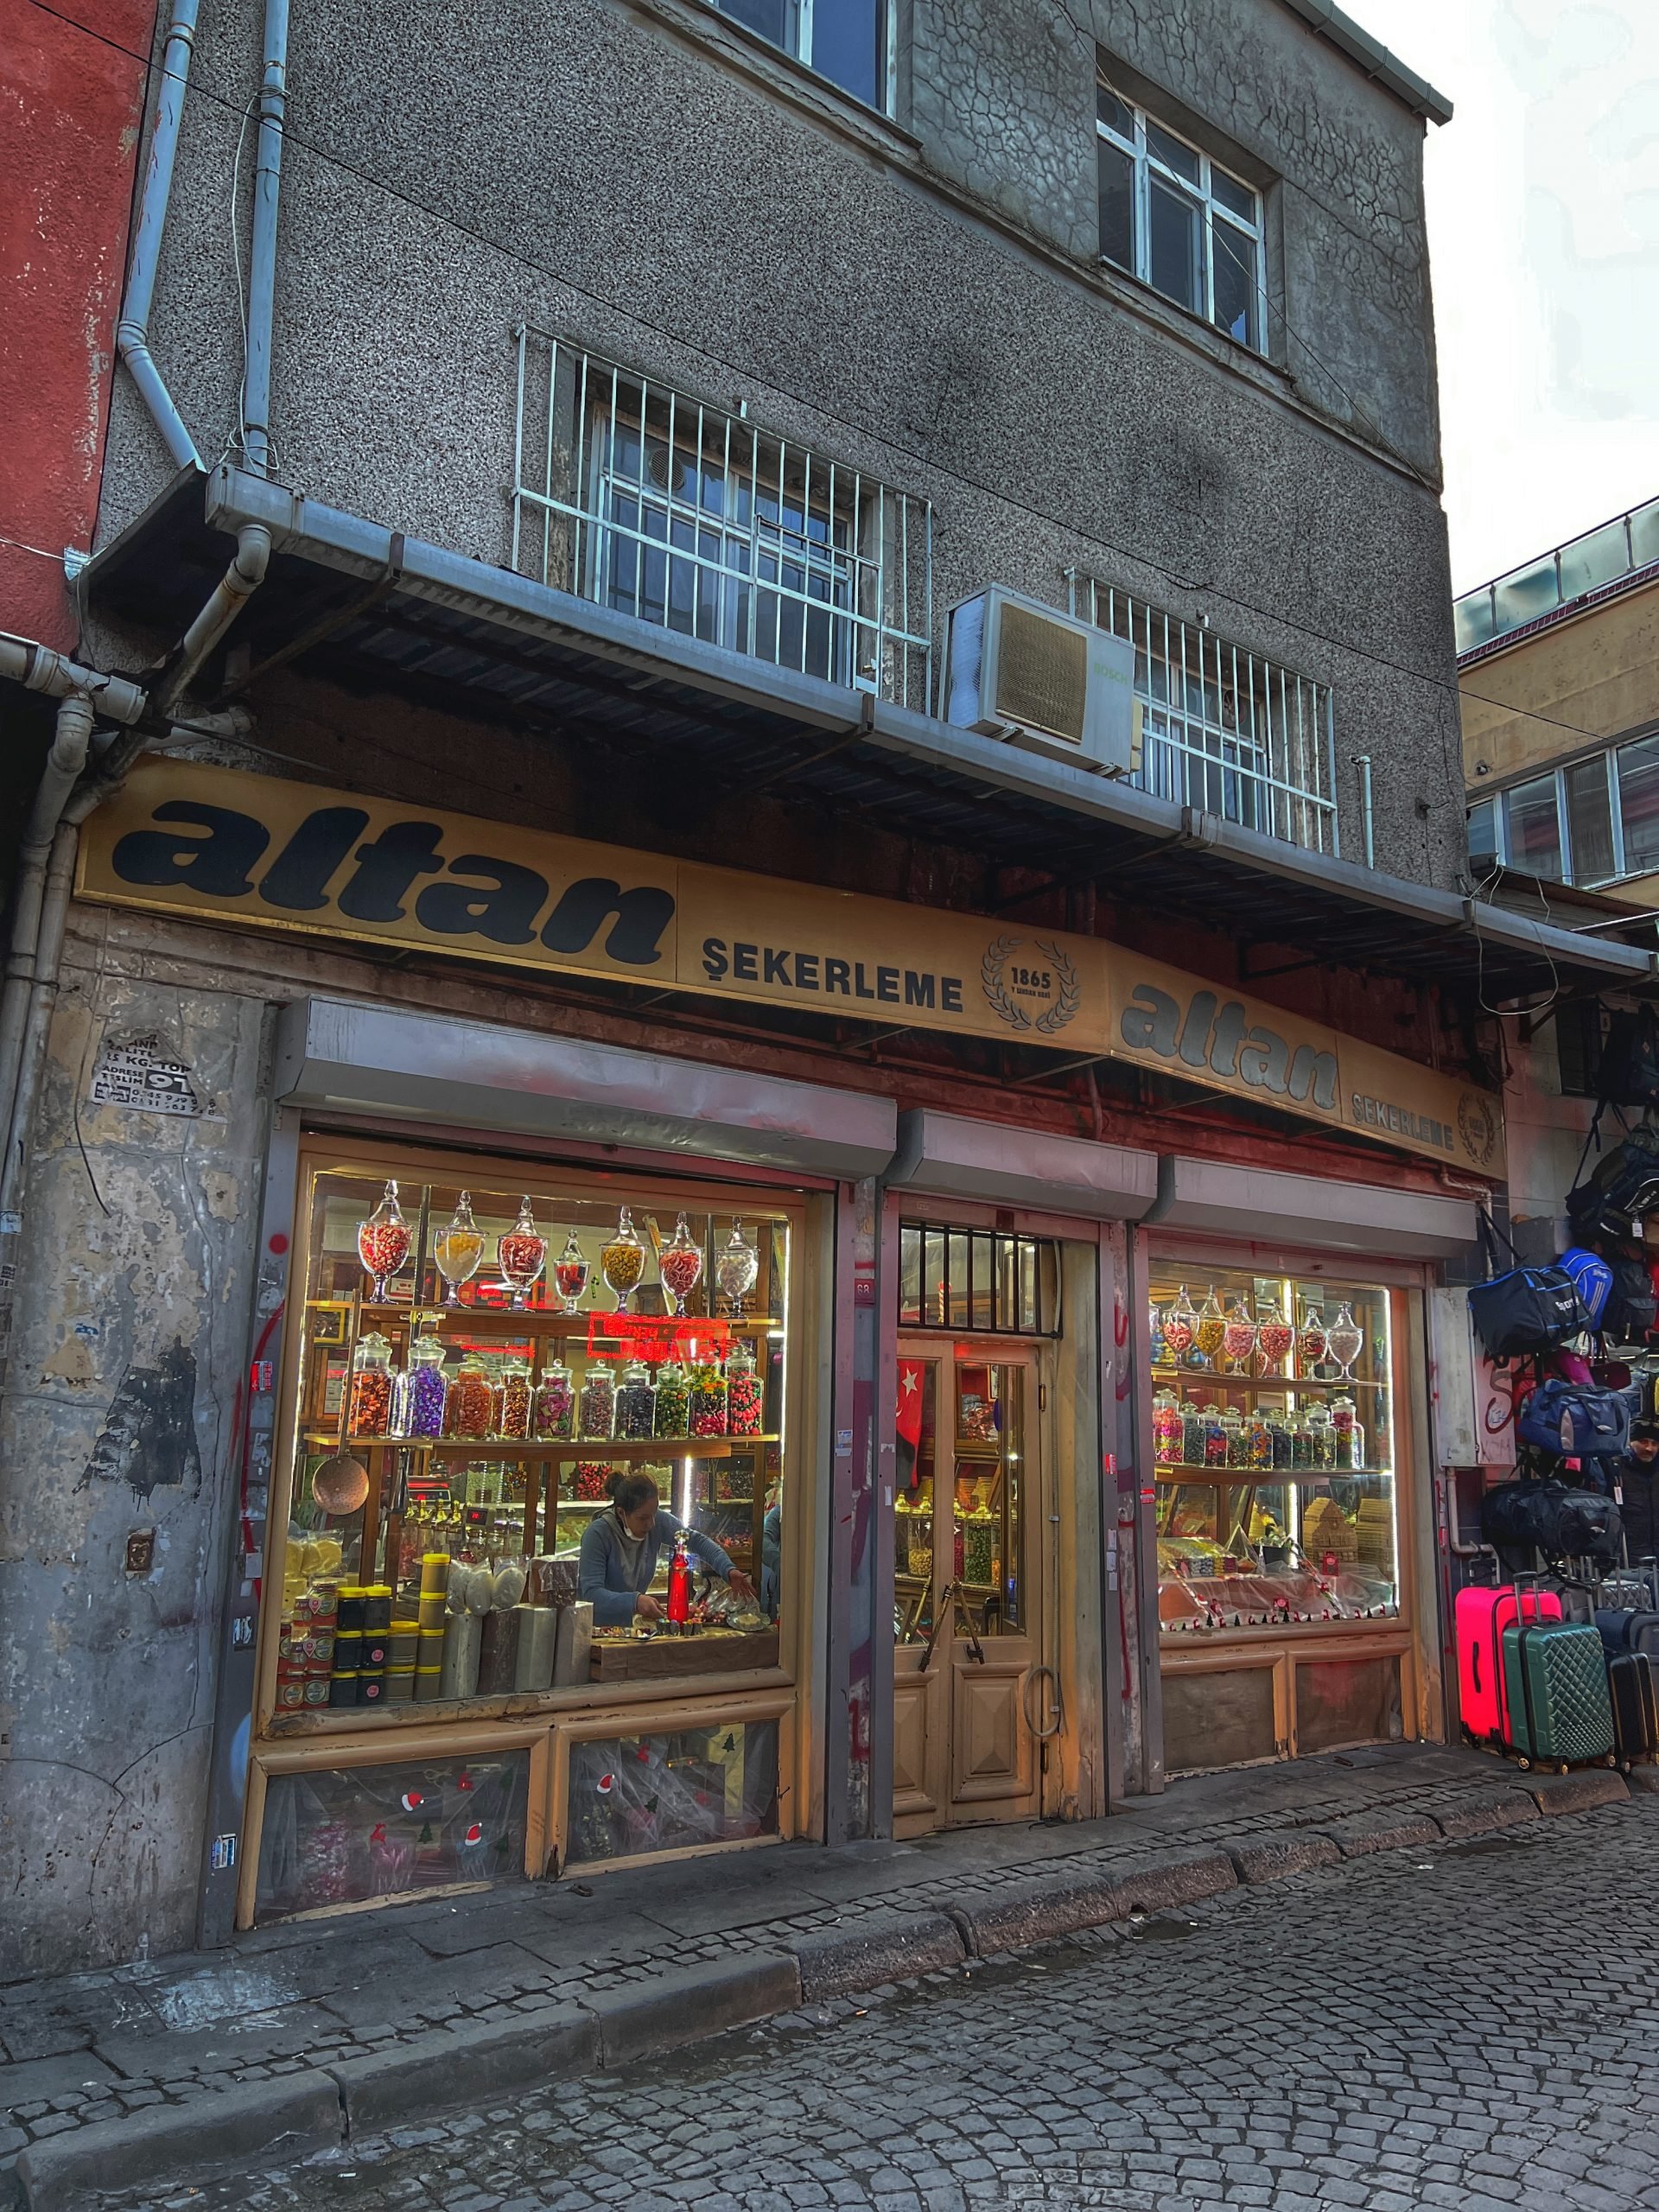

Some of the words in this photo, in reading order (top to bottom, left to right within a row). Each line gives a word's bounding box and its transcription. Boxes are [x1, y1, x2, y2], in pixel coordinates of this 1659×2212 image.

[1094, 663, 1128, 685] BOSCH
[112, 800, 676, 965] altan
[702, 938, 963, 1013] ŞEKERLEME
[1012, 968, 1051, 988] 1865
[126, 1056, 152, 1068] KG.
[1121, 983, 1338, 1110] altan
[102, 1065, 144, 1077] ADRESE
[1352, 1093, 1454, 1152] ŞEKERLEME
